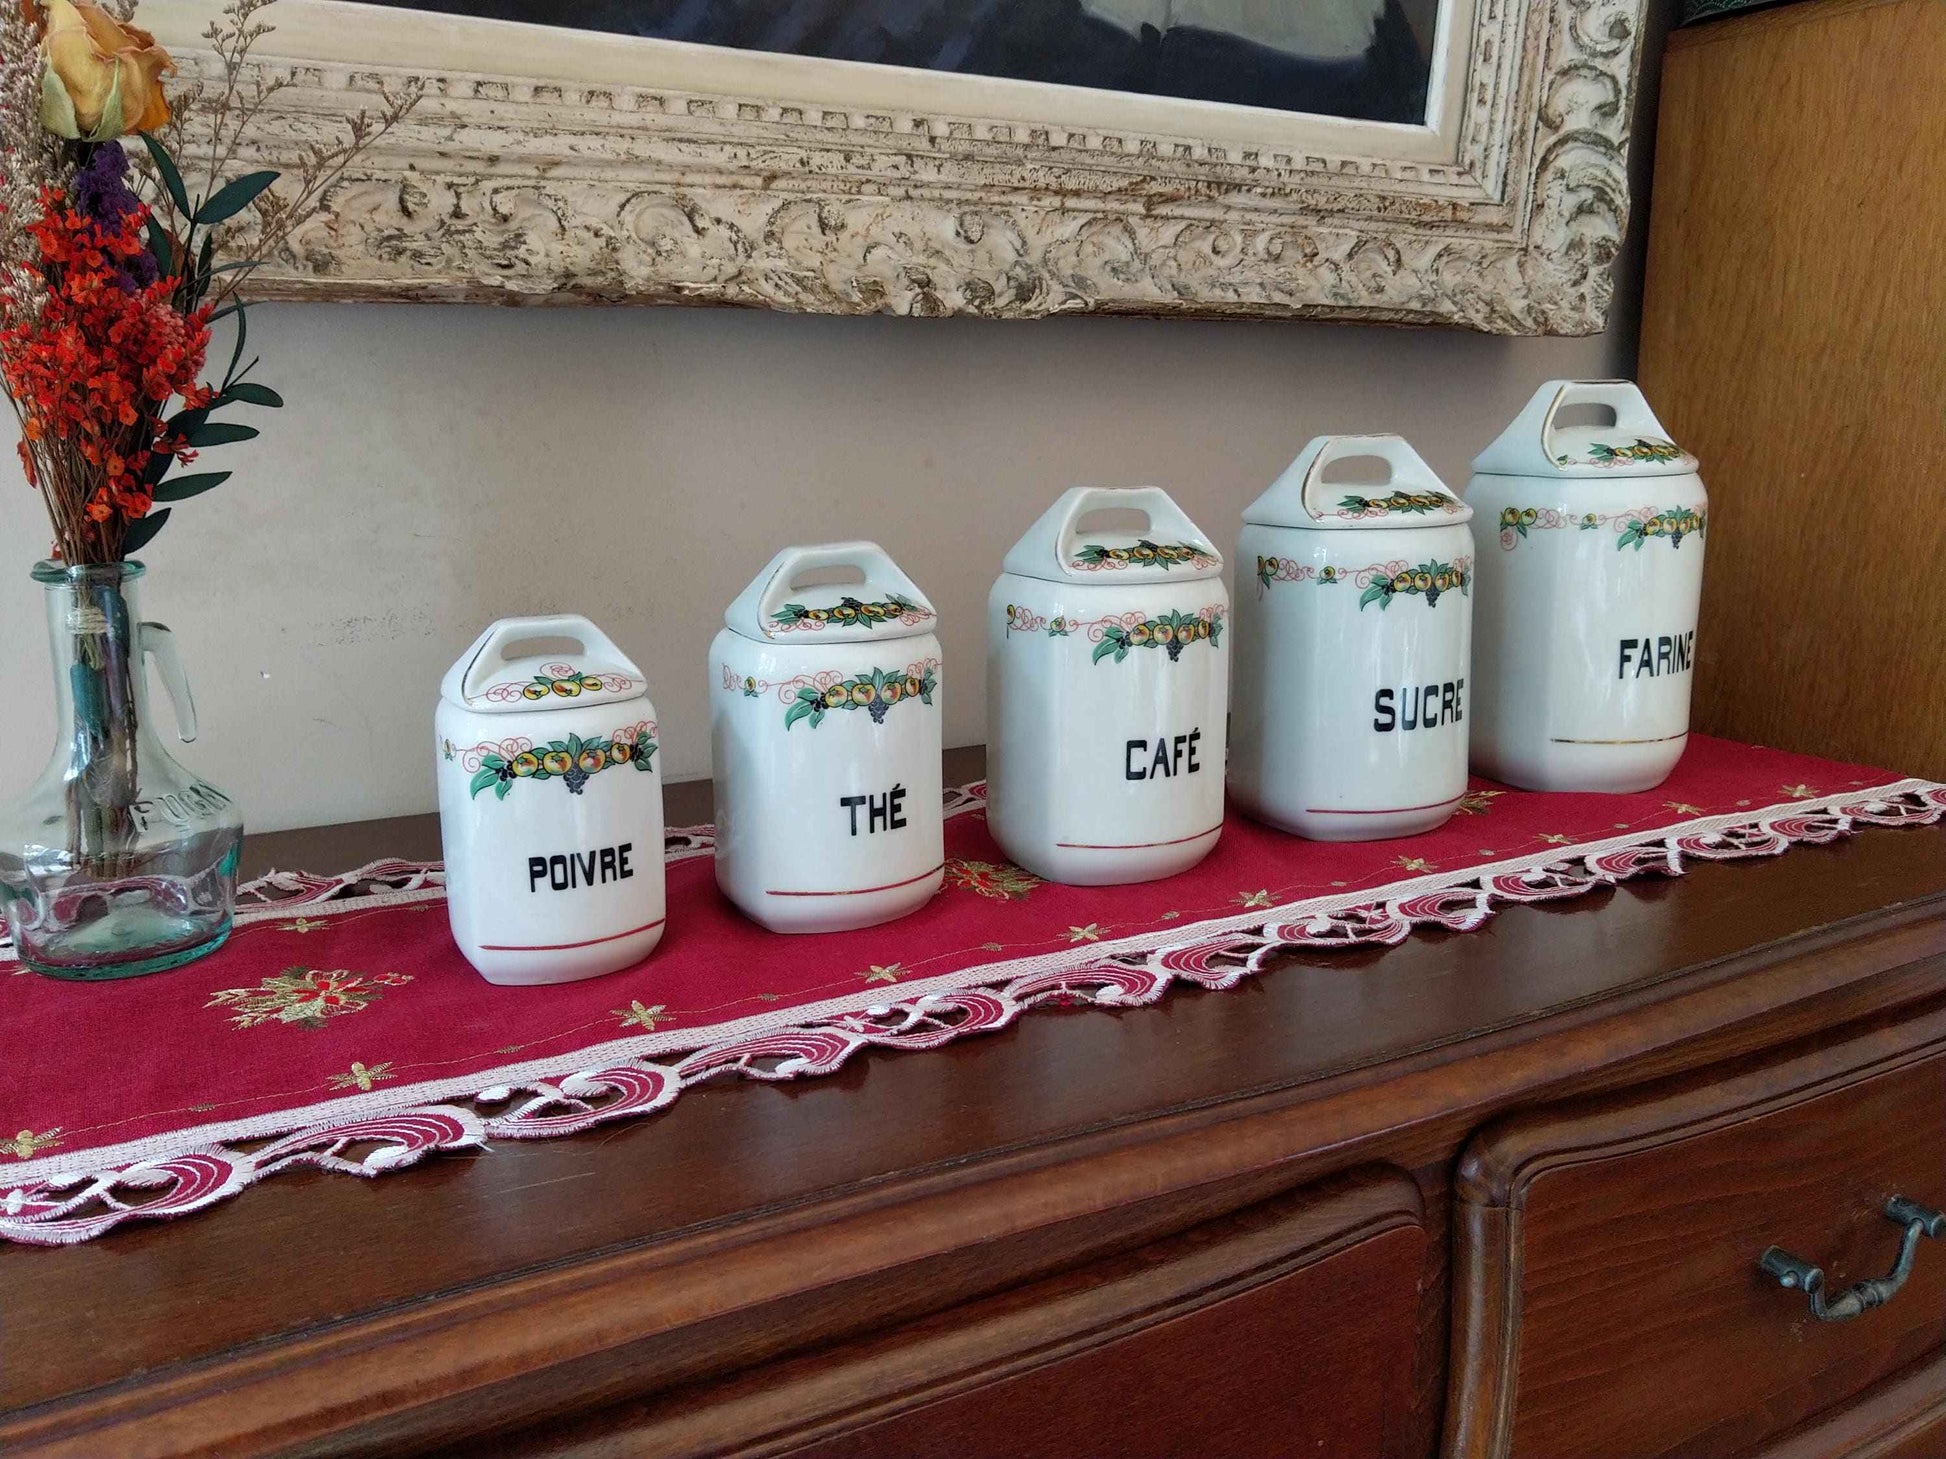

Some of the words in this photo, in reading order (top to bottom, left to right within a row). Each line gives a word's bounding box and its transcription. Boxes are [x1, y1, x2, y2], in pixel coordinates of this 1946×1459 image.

[1619, 630, 1694, 679] FARINE
[1373, 679, 1464, 732] SUCRE
[1126, 727, 1201, 780] CAFÉ
[840, 783, 907, 836] THÉ
[529, 843, 634, 892] POIVRE
